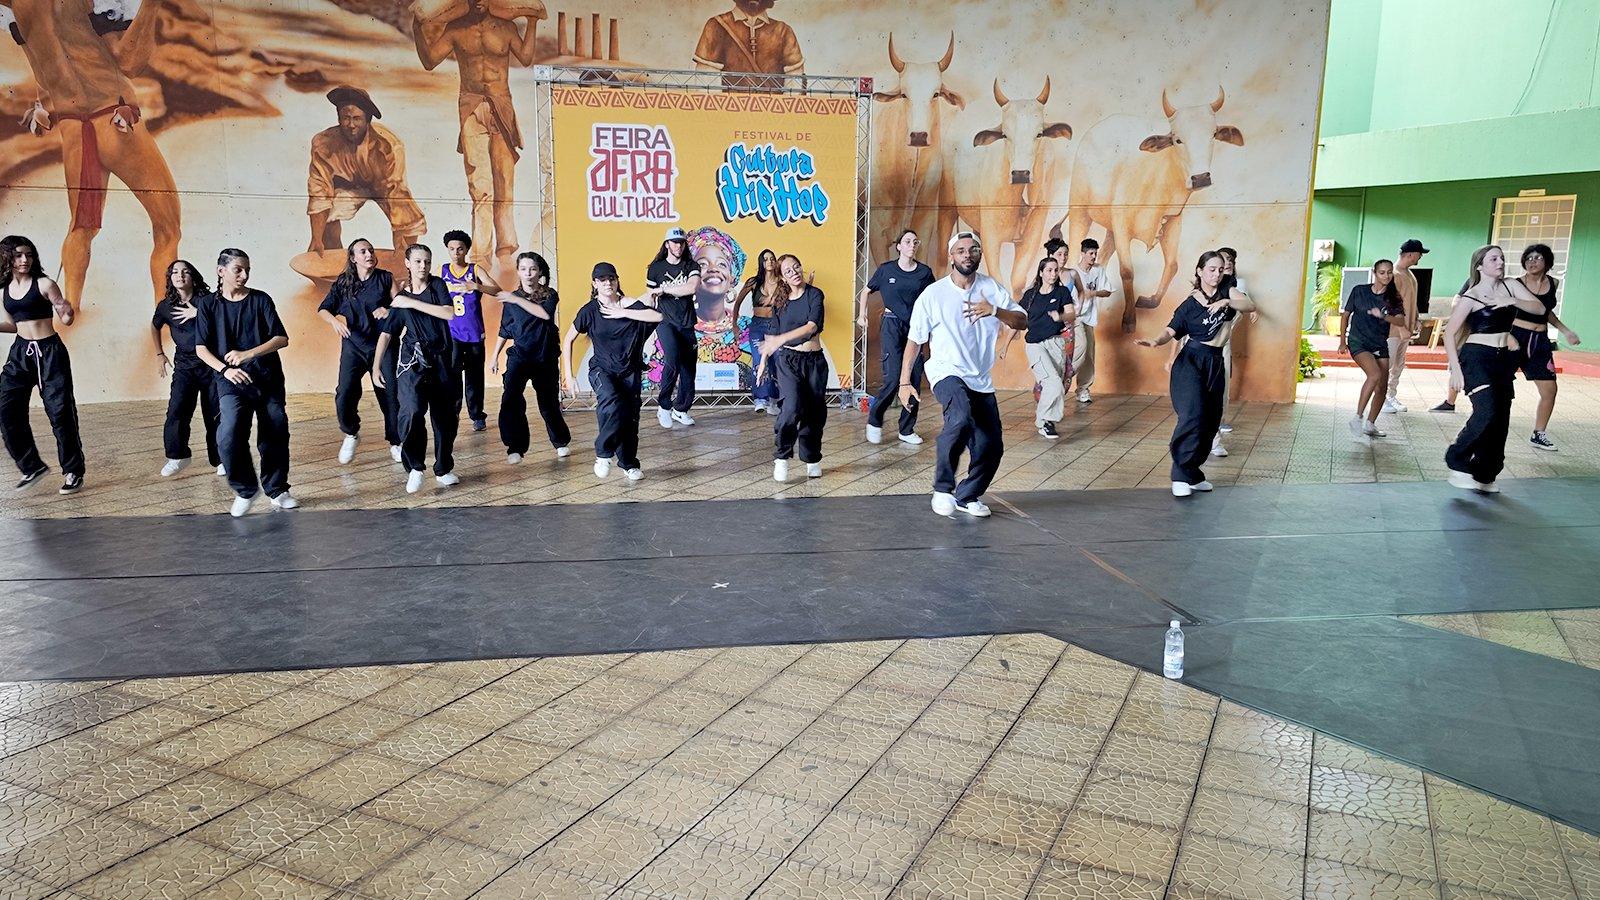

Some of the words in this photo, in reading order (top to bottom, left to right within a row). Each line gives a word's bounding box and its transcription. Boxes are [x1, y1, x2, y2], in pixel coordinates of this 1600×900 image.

[595, 127, 671, 149] FEIRA
[734, 130, 792, 141] FESTIVAL
[796, 132, 812, 141] DE
[730, 144, 814, 175] Cultura
